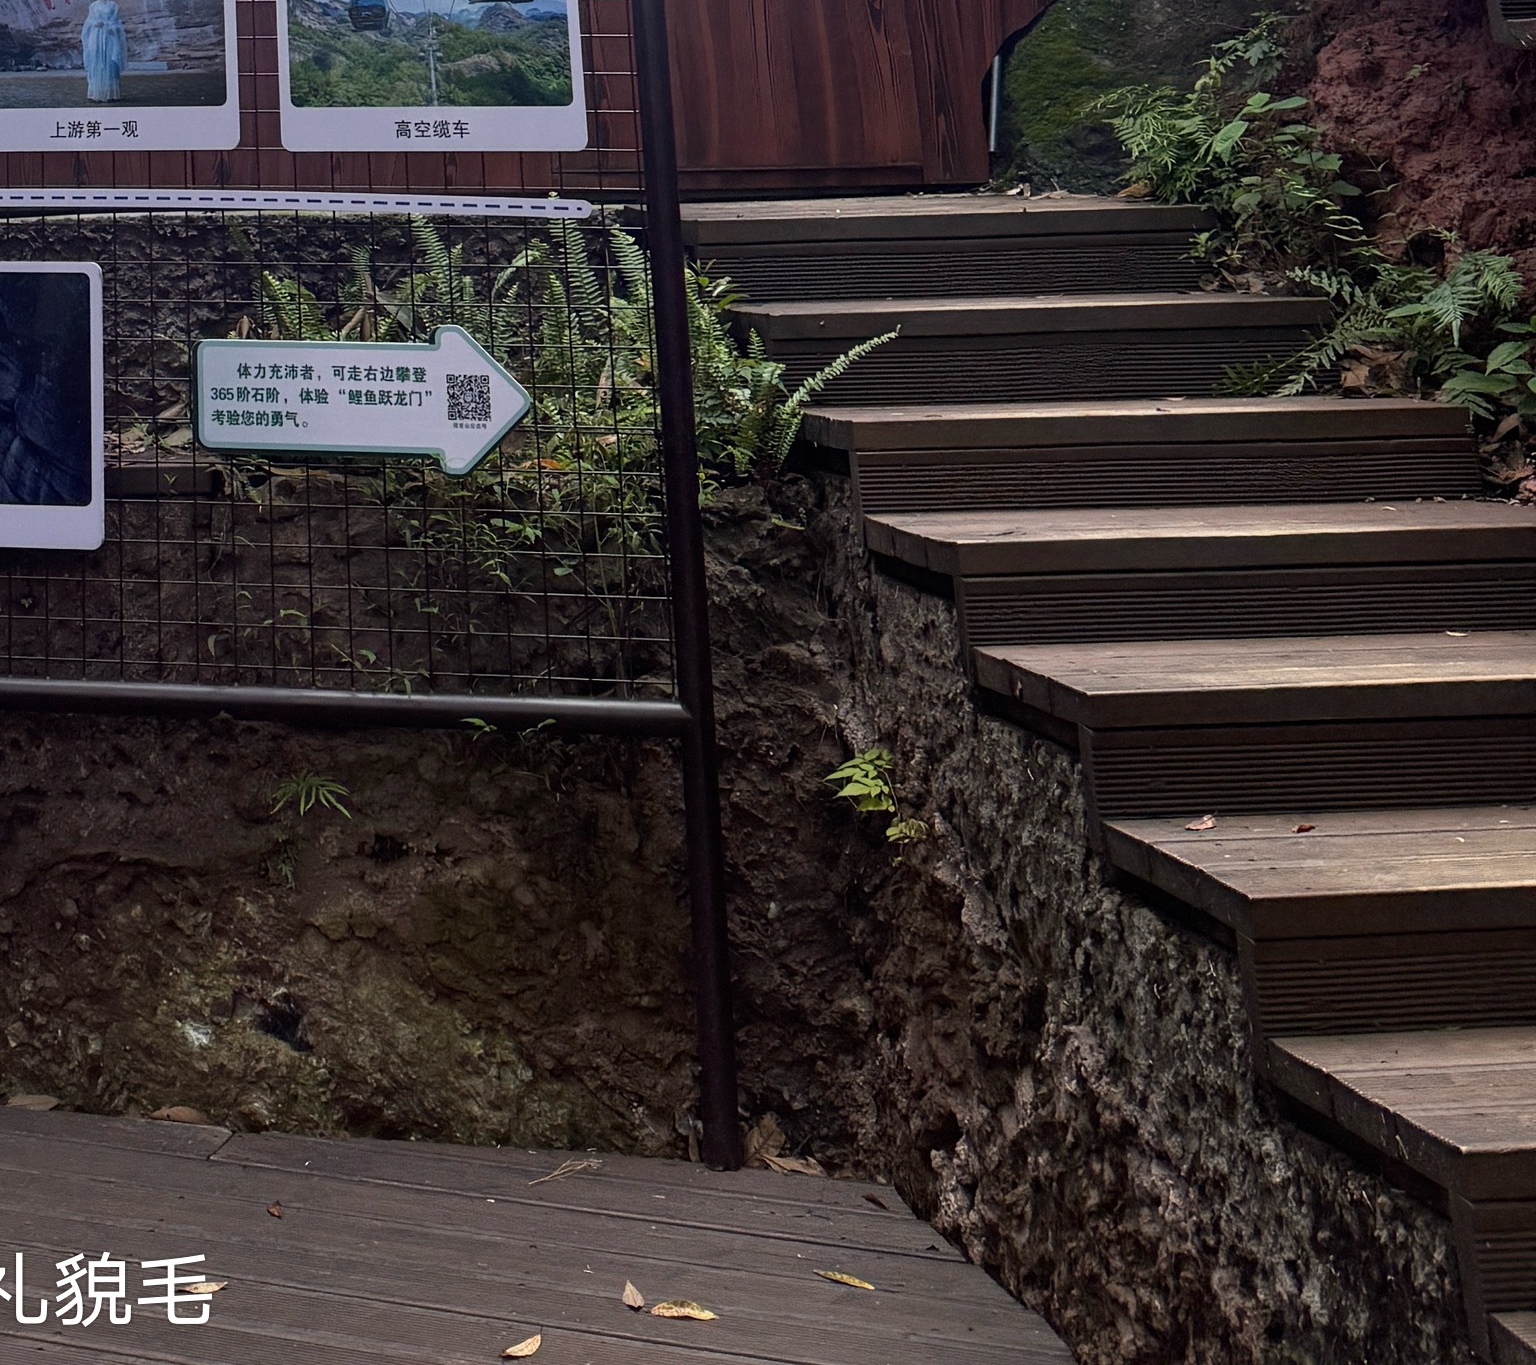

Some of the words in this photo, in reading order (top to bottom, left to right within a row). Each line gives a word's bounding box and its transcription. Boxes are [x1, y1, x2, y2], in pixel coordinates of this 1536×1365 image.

[49, 120, 139, 139] 上游第一观
[394, 119, 471, 139] 高空缆车
[211, 409, 309, 428] 考验您的勇气。
